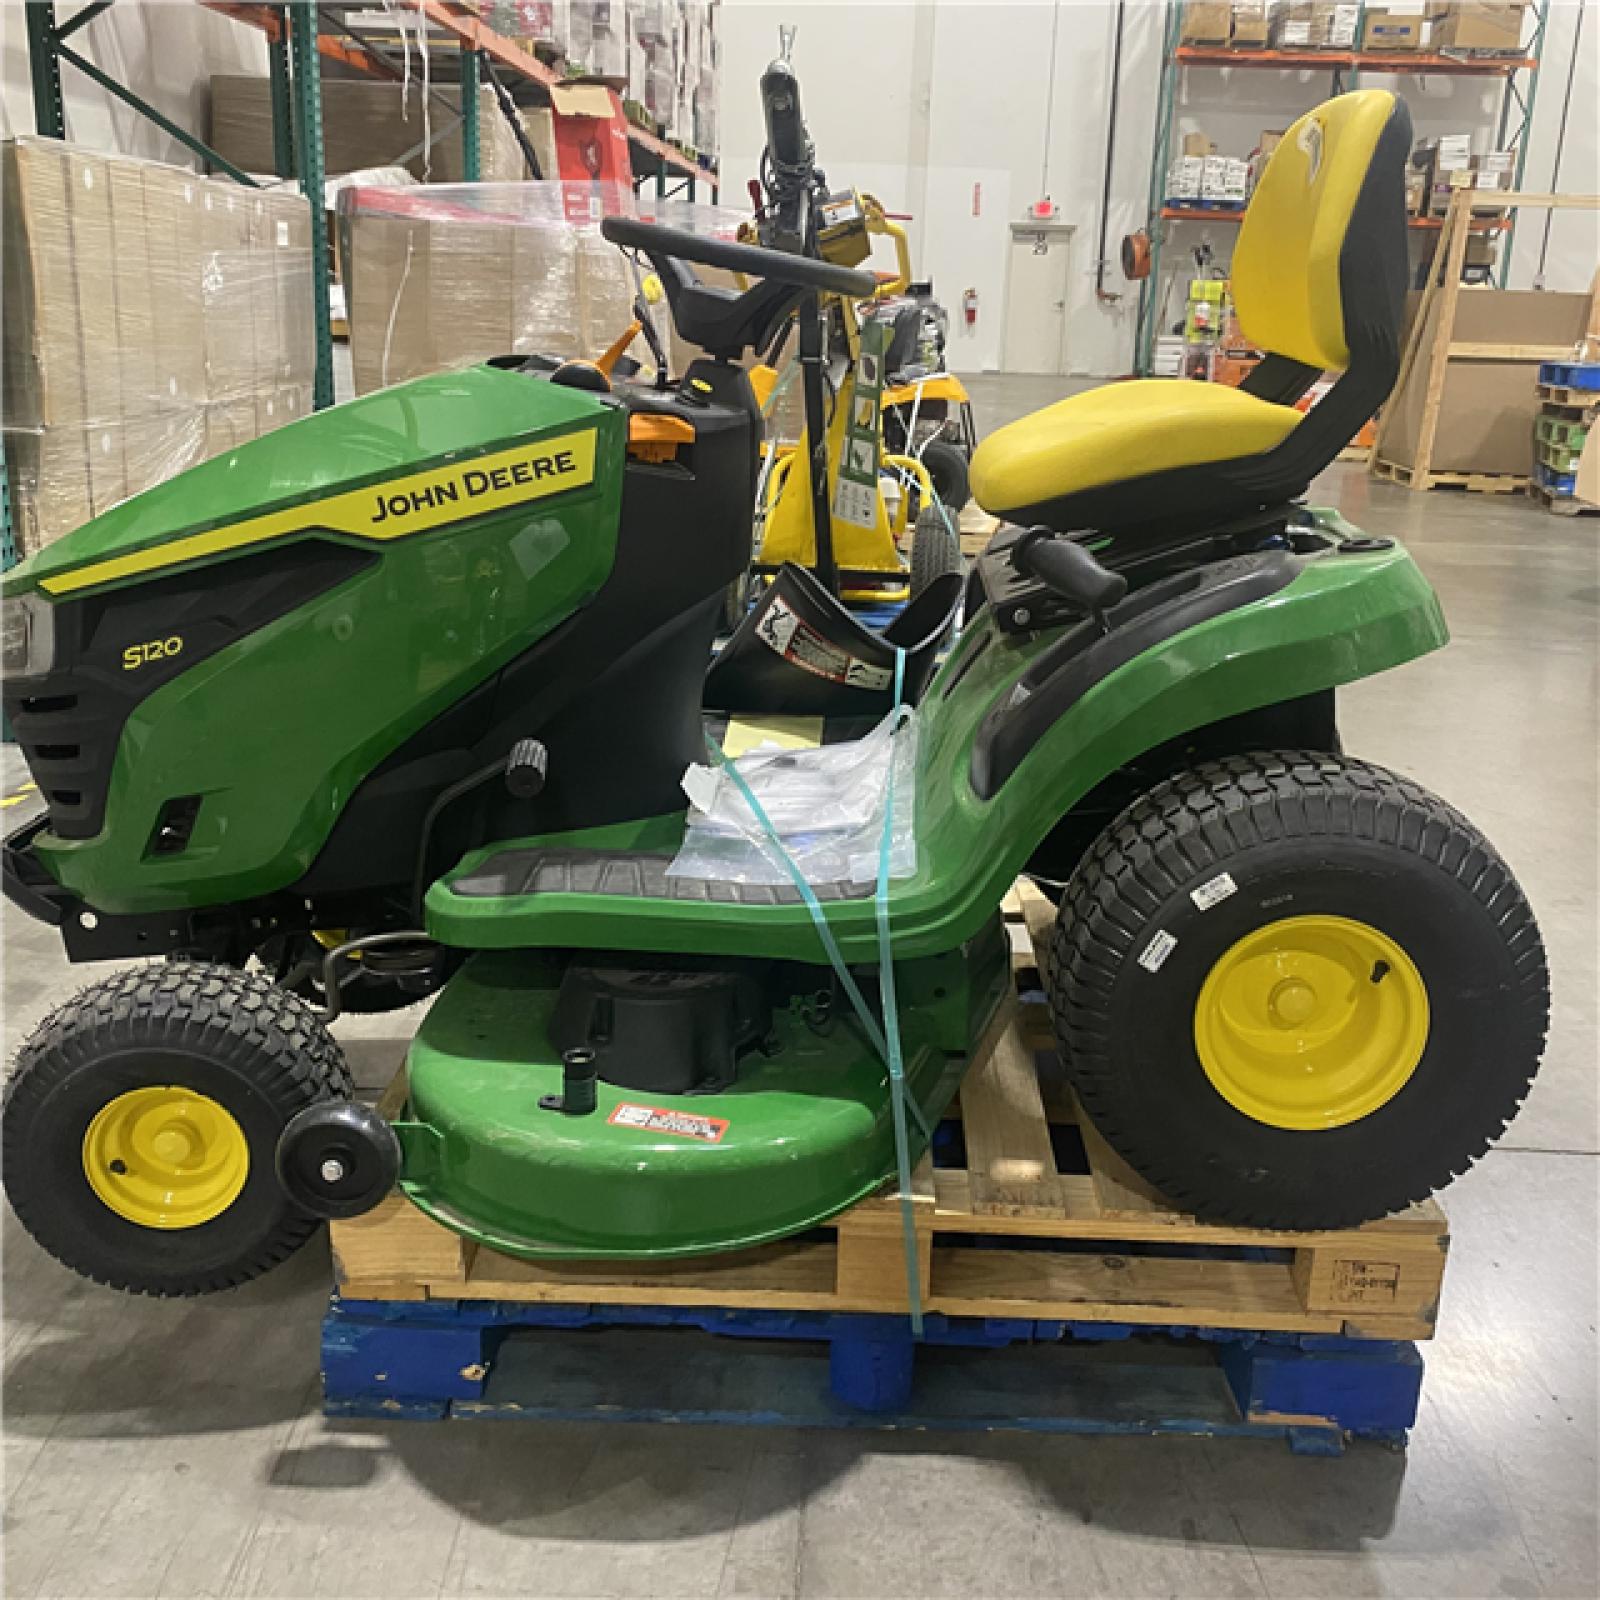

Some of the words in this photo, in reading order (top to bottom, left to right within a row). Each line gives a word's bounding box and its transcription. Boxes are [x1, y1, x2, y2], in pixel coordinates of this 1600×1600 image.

[371, 482, 459, 523] JOHN
[462, 450, 577, 498] DEERE
[122, 635, 183, 670] S120
